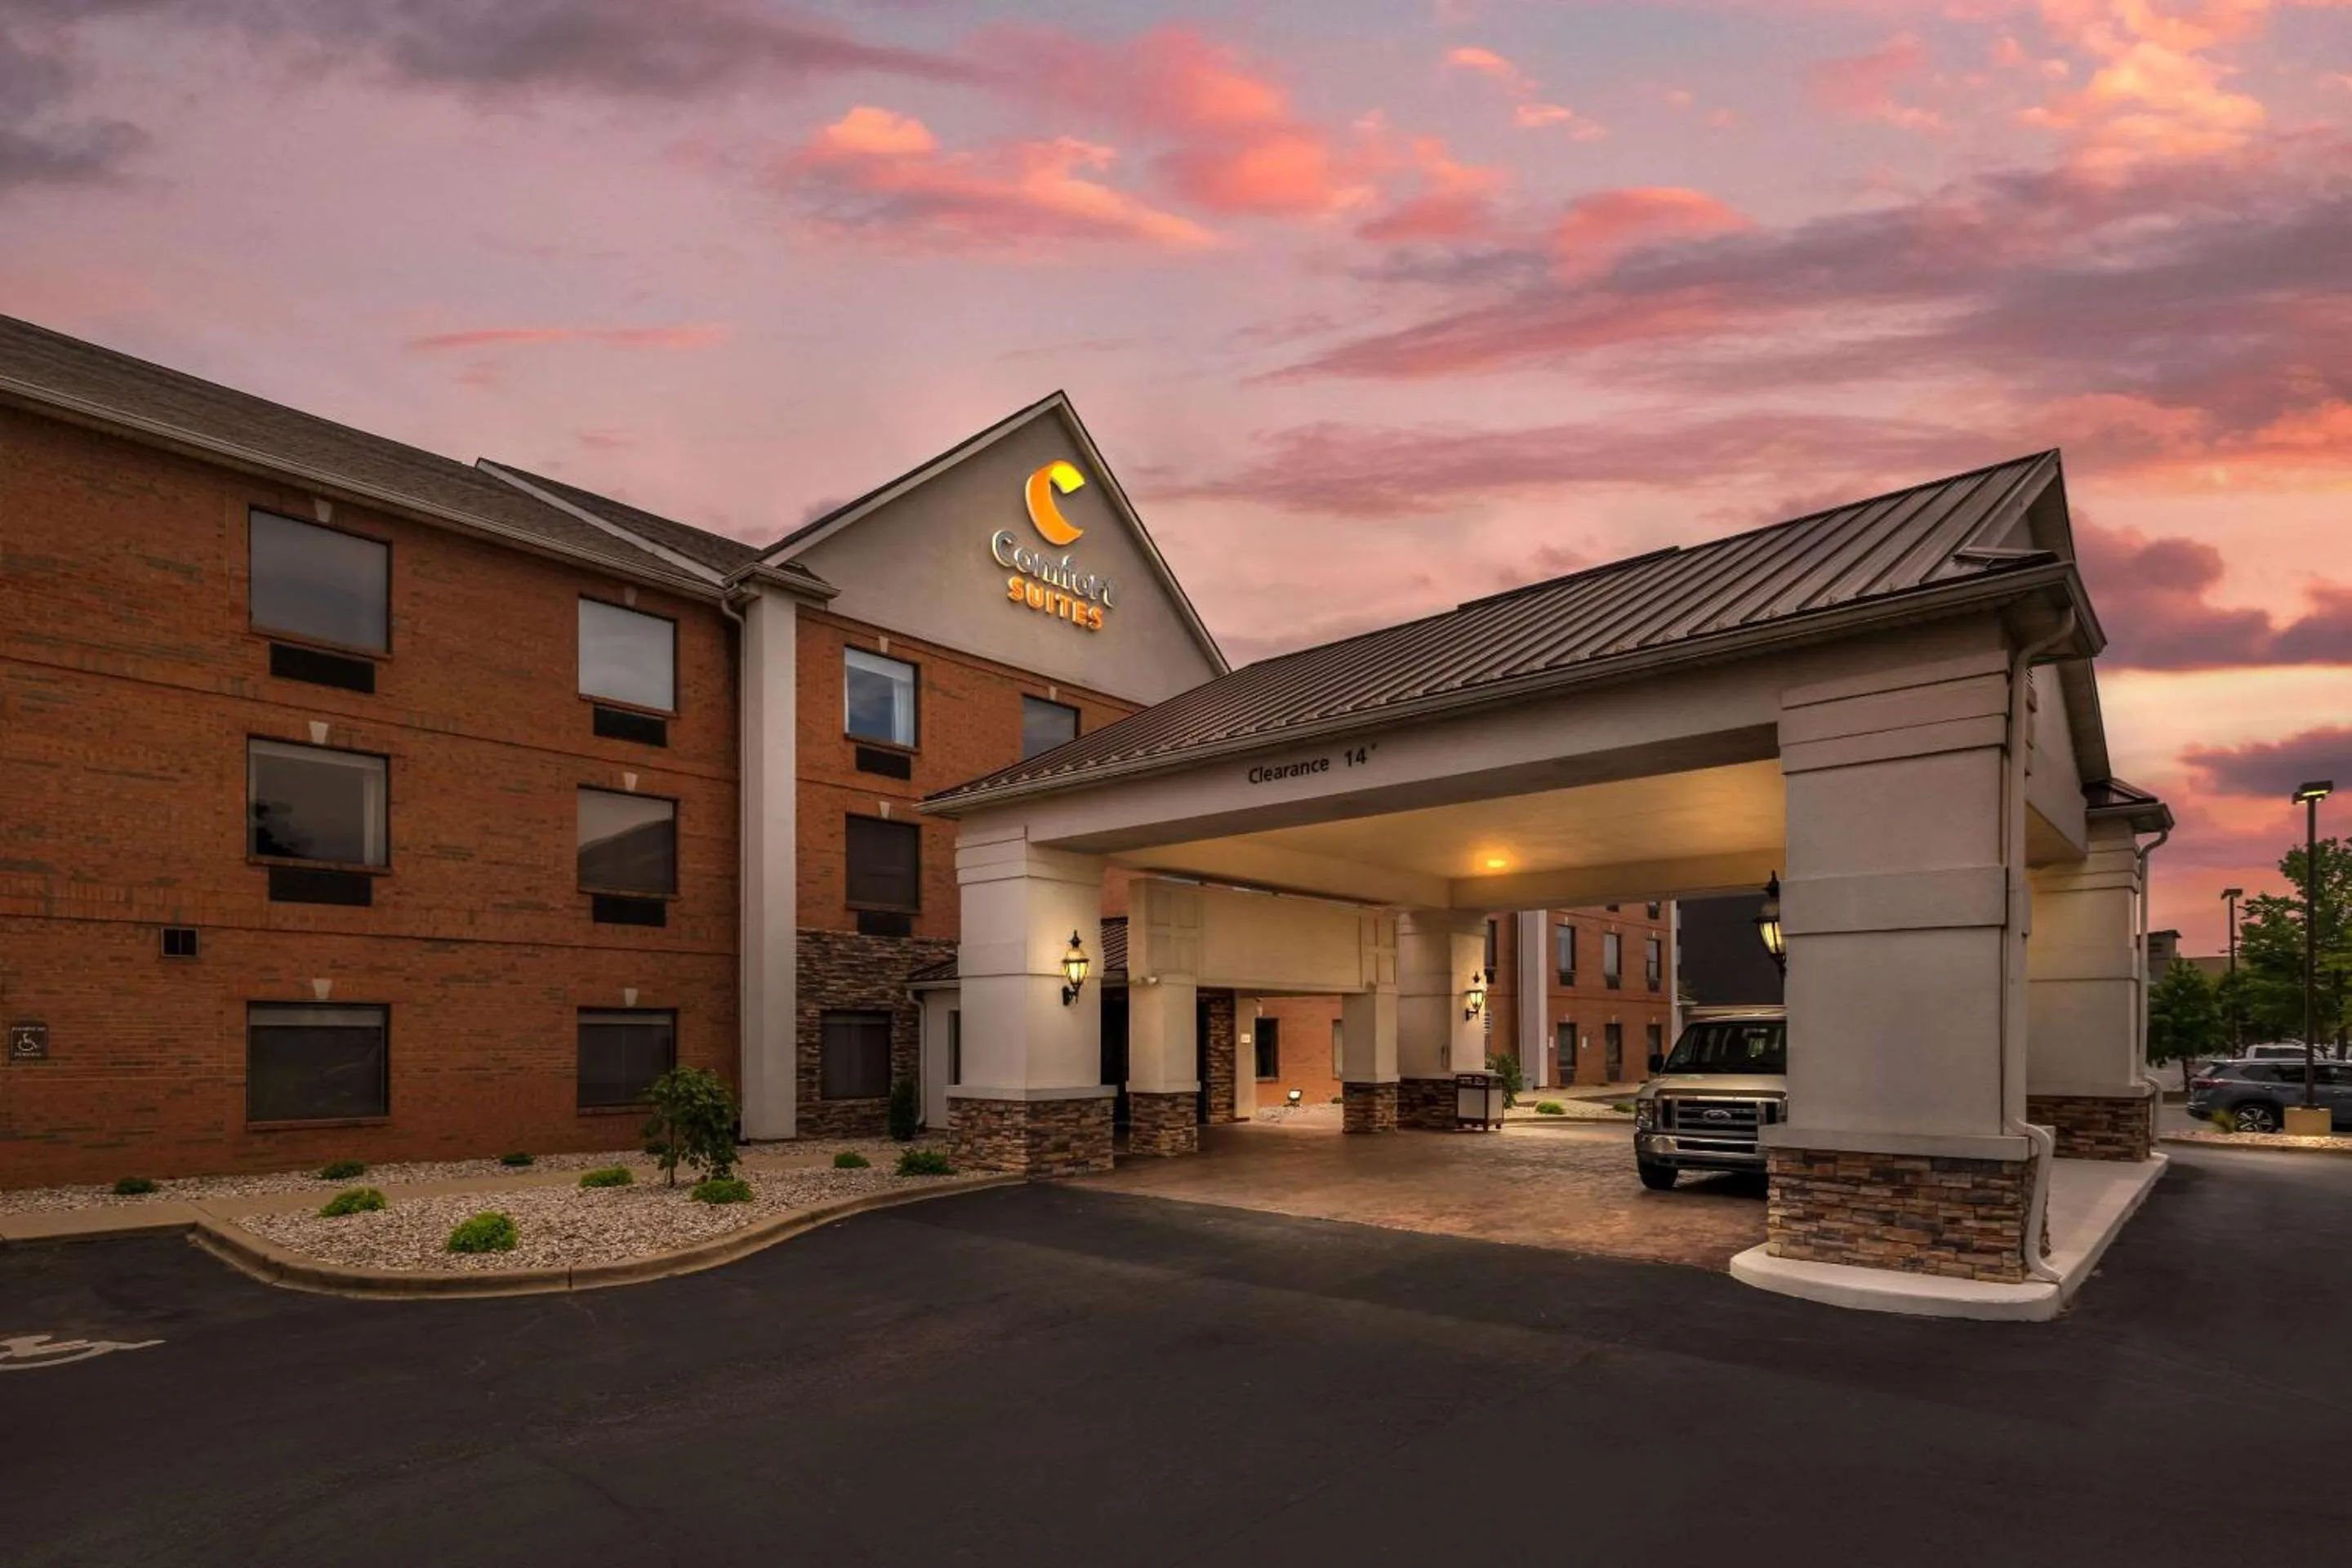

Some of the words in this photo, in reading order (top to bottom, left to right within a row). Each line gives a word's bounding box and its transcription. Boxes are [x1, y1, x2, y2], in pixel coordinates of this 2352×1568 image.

[991, 529, 1116, 608] Comfort
[1007, 575, 1103, 630] SUITES
[1248, 758, 1330, 784] Clearance
